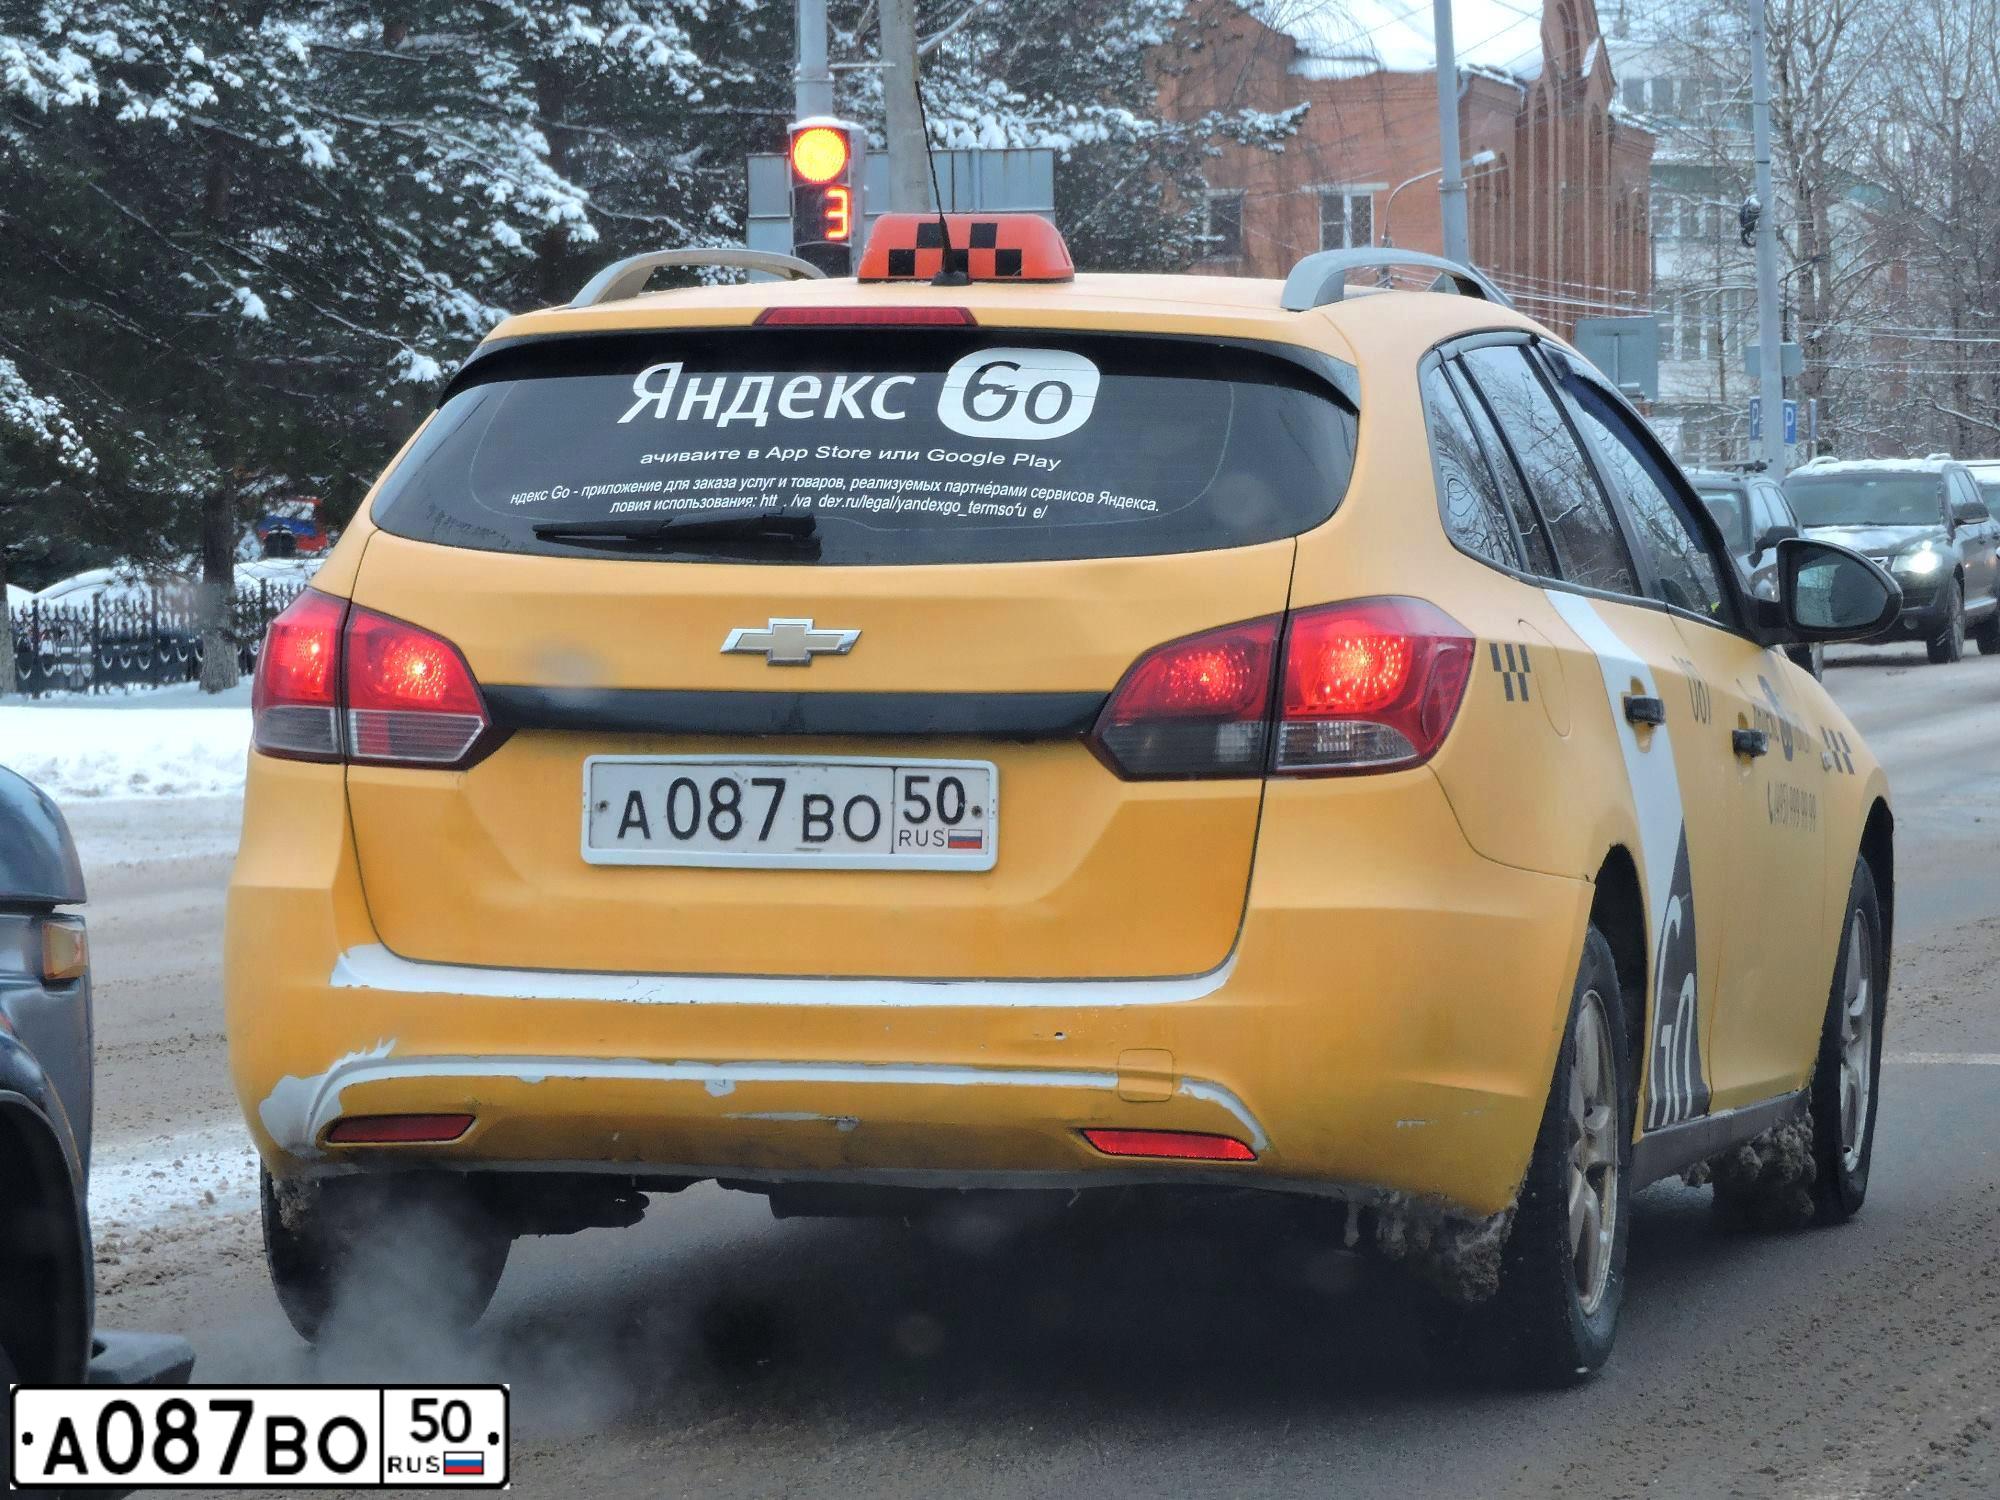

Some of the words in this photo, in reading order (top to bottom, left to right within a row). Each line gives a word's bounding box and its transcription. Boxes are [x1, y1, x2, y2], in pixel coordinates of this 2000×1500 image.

[826, 188, 849, 239] 3
[617, 361, 916, 427] Яндекс
[962, 361, 1073, 425] Go
[1785, 407, 1794, 439] P
[748, 449, 759, 459] в
[765, 447, 808, 461] App
[815, 446, 872, 460] Store
[878, 450, 920, 461] или
[927, 448, 1005, 467] Google
[1012, 453, 1062, 472] Play
[551, 485, 570, 499] Go
[581, 479, 662, 498] приложение
[664, 480, 690, 492] для
[692, 477, 736, 490] заказа
[738, 476, 777, 491] услуг
[778, 478, 787, 487] и
[791, 477, 846, 490] товаров,
[849, 478, 941, 492] реализуемых
[1030, 486, 1095, 504] сервисов
[1098, 490, 1160, 512] Яндекса.
[654, 496, 757, 510] использования:
[903, 775, 966, 825] 50
[899, 829, 946, 847] RUS
